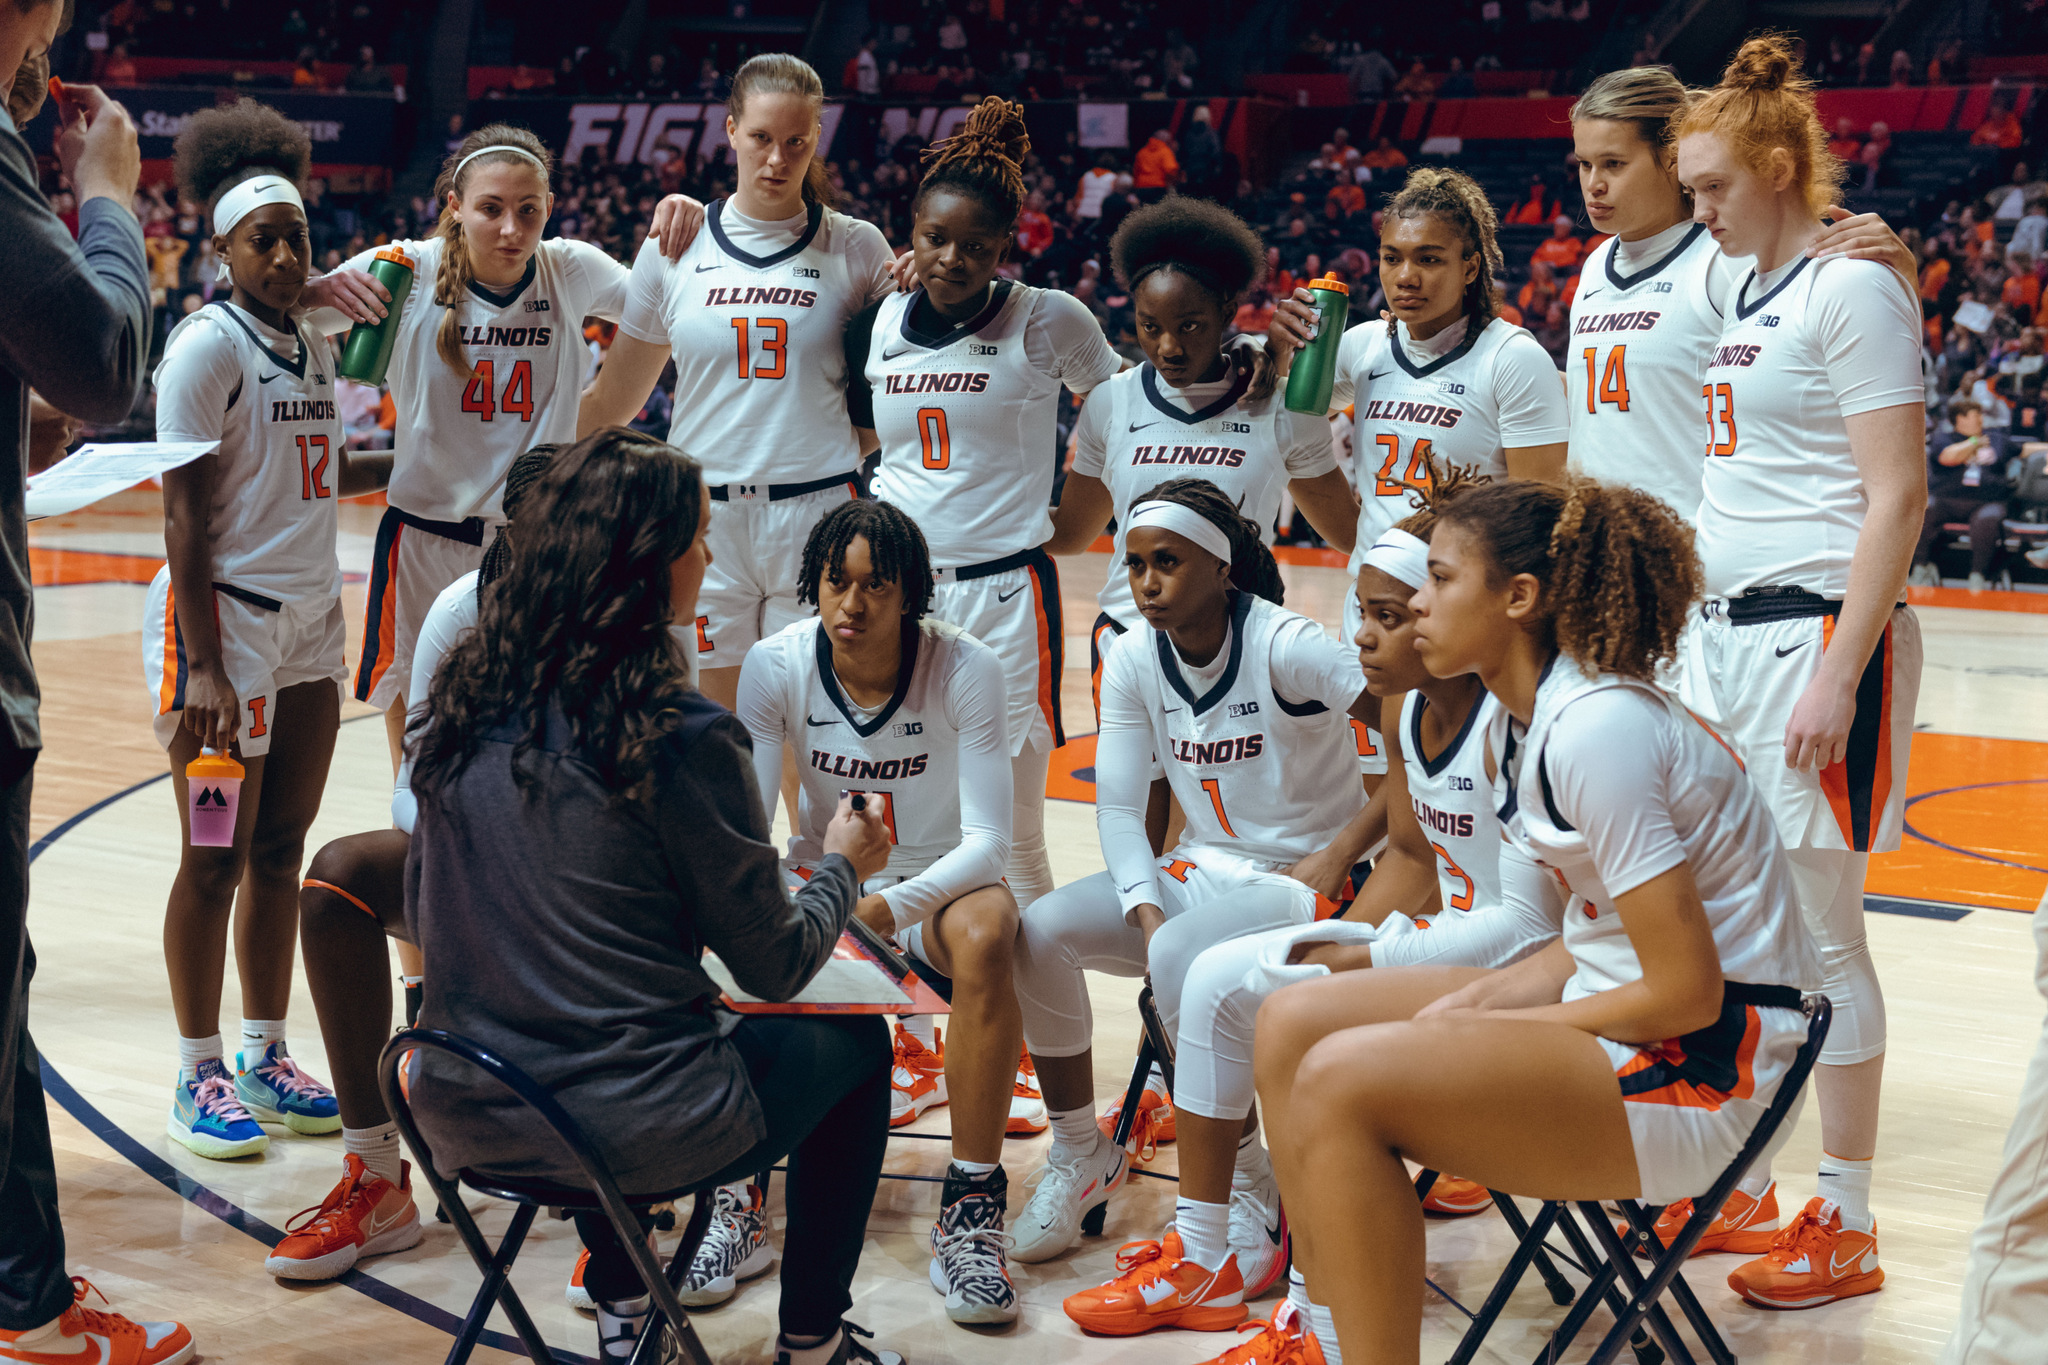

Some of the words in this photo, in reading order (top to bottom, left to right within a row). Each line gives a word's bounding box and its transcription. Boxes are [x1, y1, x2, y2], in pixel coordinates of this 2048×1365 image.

[705, 287, 818, 308] ILLINOIS
[459, 325, 552, 347] LLINOIS
[1573, 311, 1661, 336] ILLINOIS
[731, 317, 788, 380] 13
[1709, 344, 1762, 368] LINOIS
[461, 360, 534, 422] 44
[885, 372, 990, 395] ILLINOIS
[1583, 344, 1630, 414] 14
[271, 400, 336, 422] ILLINOIS
[1364, 400, 1463, 429] ILLINOIS
[1702, 383, 1738, 457] 33
[917, 407, 951, 471] 0
[1131, 445, 1247, 468] ILLINOIS
[295, 434, 331, 501] 12
[1375, 433, 1434, 497] 24
[811, 749, 929, 780] ILLINOIS
[1169, 733, 1264, 765] LLINOIS
[1200, 778, 1239, 838] 1
[1414, 798, 1474, 838] LINOIS
[1431, 840, 1475, 912] 3
